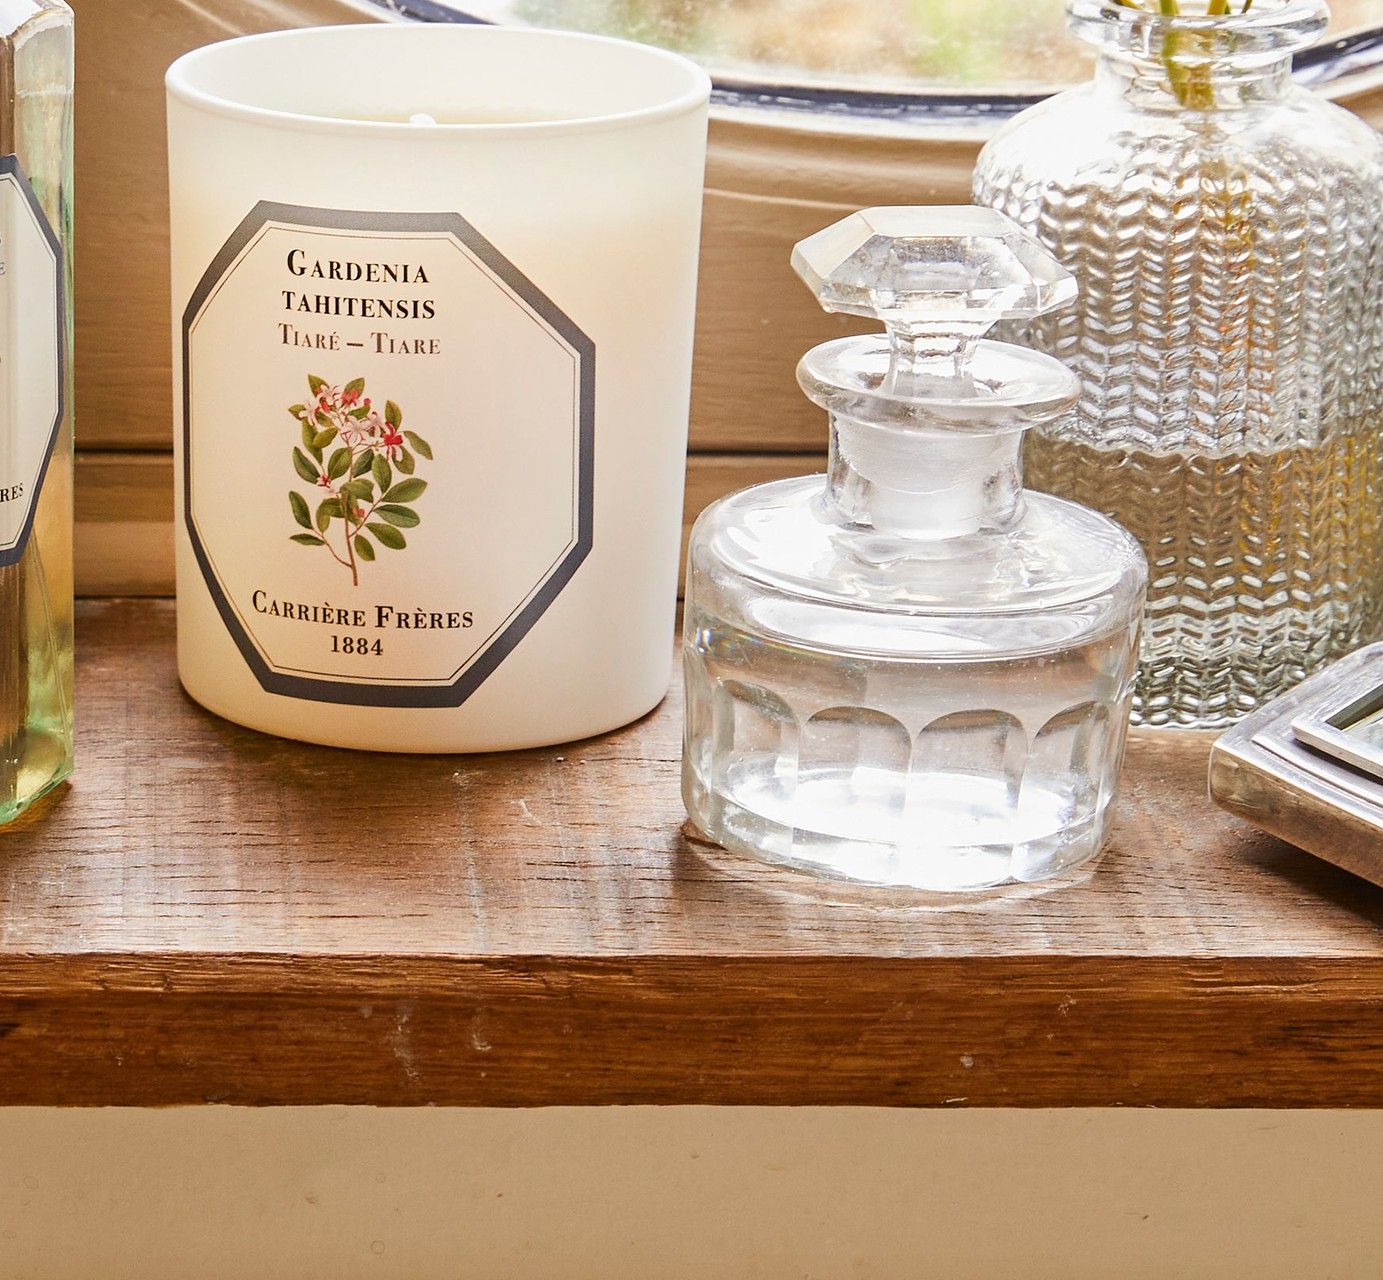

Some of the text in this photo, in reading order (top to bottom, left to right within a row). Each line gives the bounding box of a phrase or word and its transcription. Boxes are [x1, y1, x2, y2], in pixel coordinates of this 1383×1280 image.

[287, 248, 430, 284] GARDENIA
[281, 290, 436, 320] TAHITENSIS
[278, 322, 341, 352] TIARÉ
[370, 332, 442, 355] TIARE
[252, 589, 474, 629] CARRIÈRE FRÈRES
[330, 635, 384, 657] 1884
